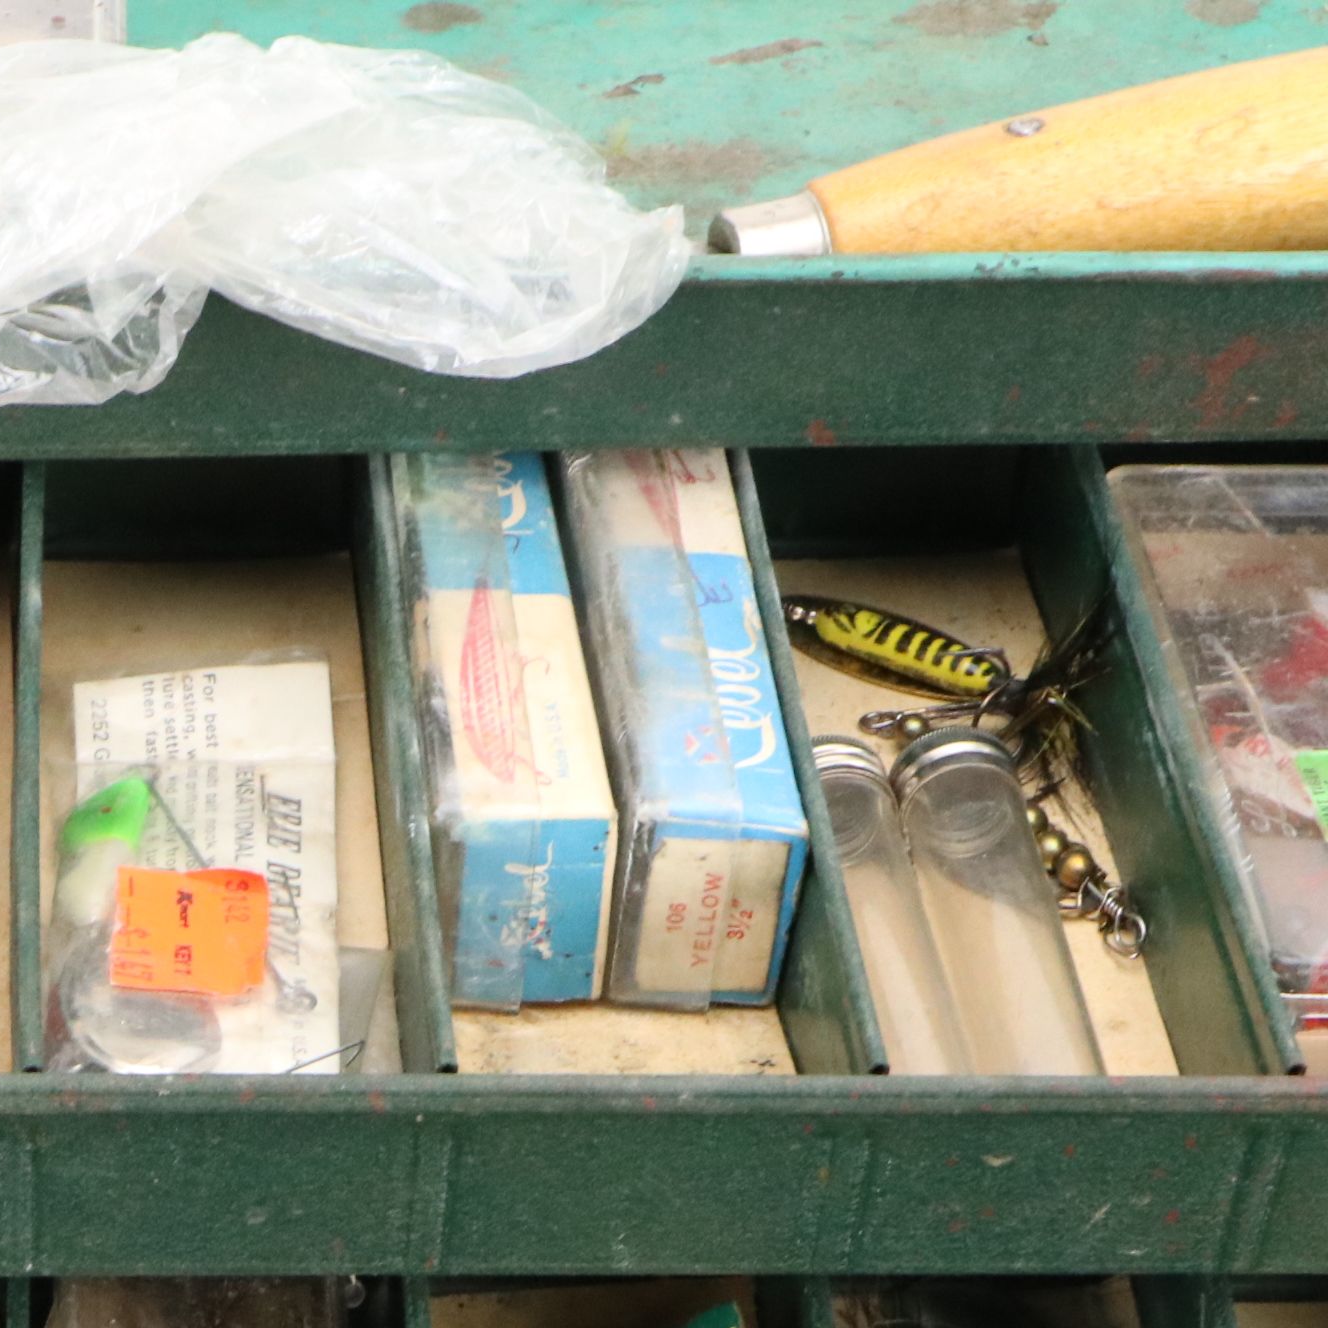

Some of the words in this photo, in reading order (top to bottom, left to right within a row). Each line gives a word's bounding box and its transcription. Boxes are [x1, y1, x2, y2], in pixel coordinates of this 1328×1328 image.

[142, 680, 157, 719] then
[162, 677, 178, 710] lure
[181, 675, 197, 740] casting,
[203, 673, 216, 703] For
[90, 699, 110, 742] 2252
[205, 713, 219, 748] best
[690, 873, 724, 967] YELLOW
